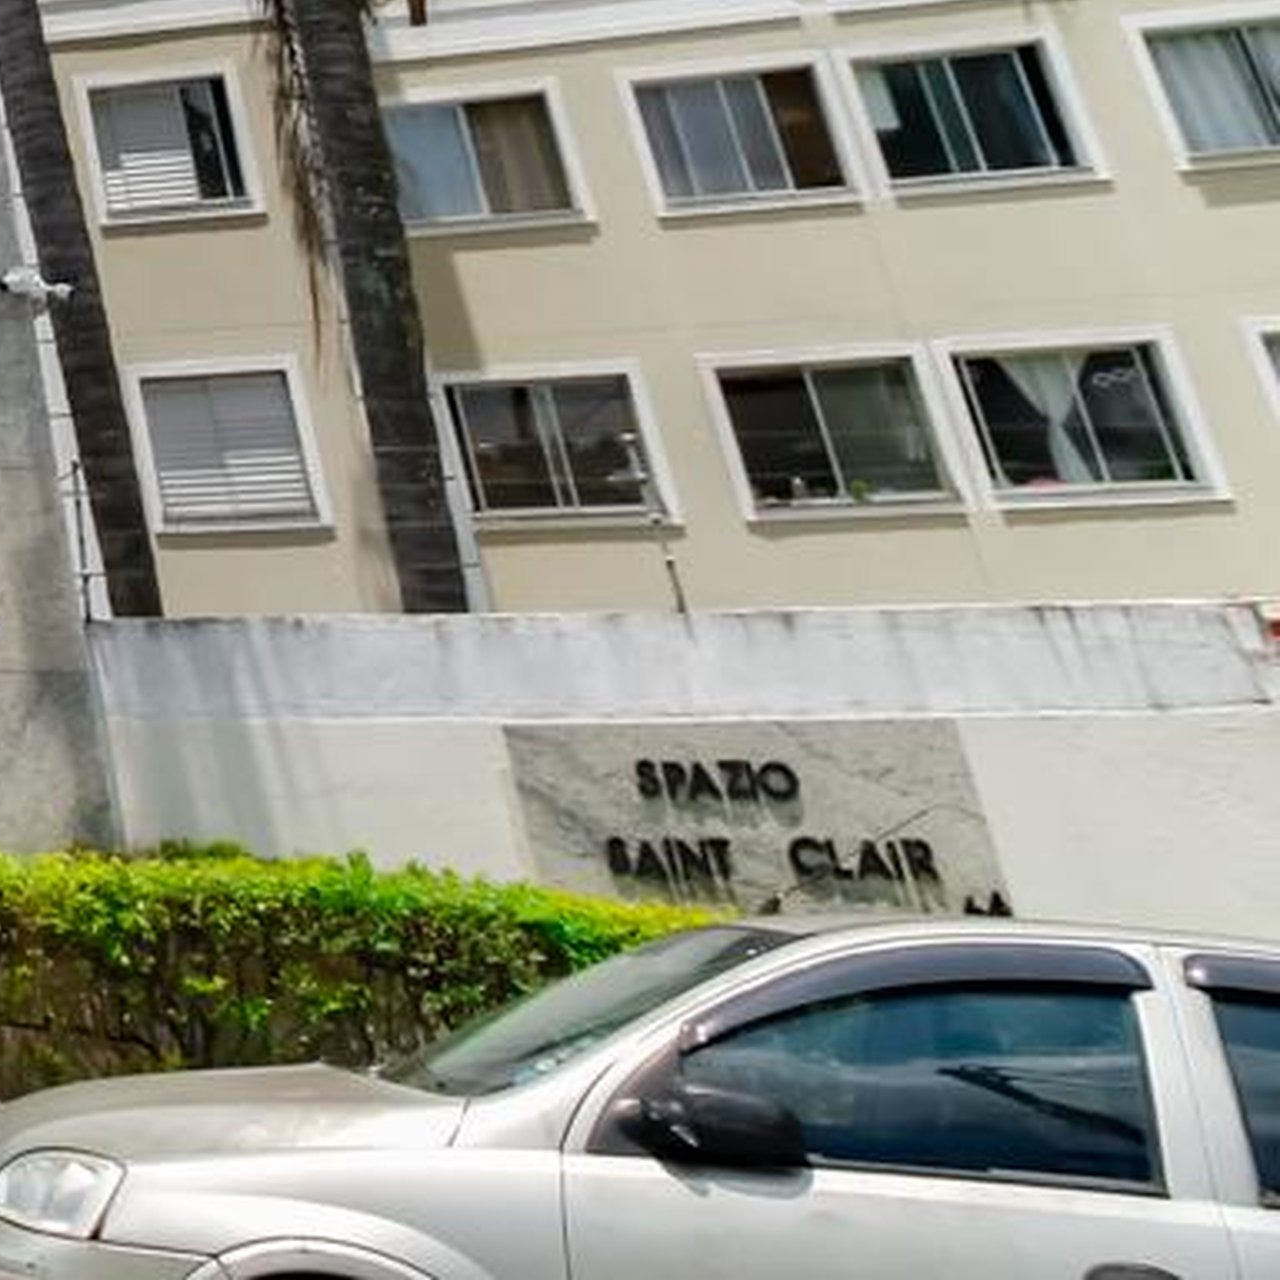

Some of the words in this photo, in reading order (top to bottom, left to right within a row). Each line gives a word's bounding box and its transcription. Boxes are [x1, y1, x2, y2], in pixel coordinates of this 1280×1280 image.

[635, 760, 800, 800] SPAZIO
[607, 836, 732, 882] SAINT
[788, 836, 940, 882] CLAIR
